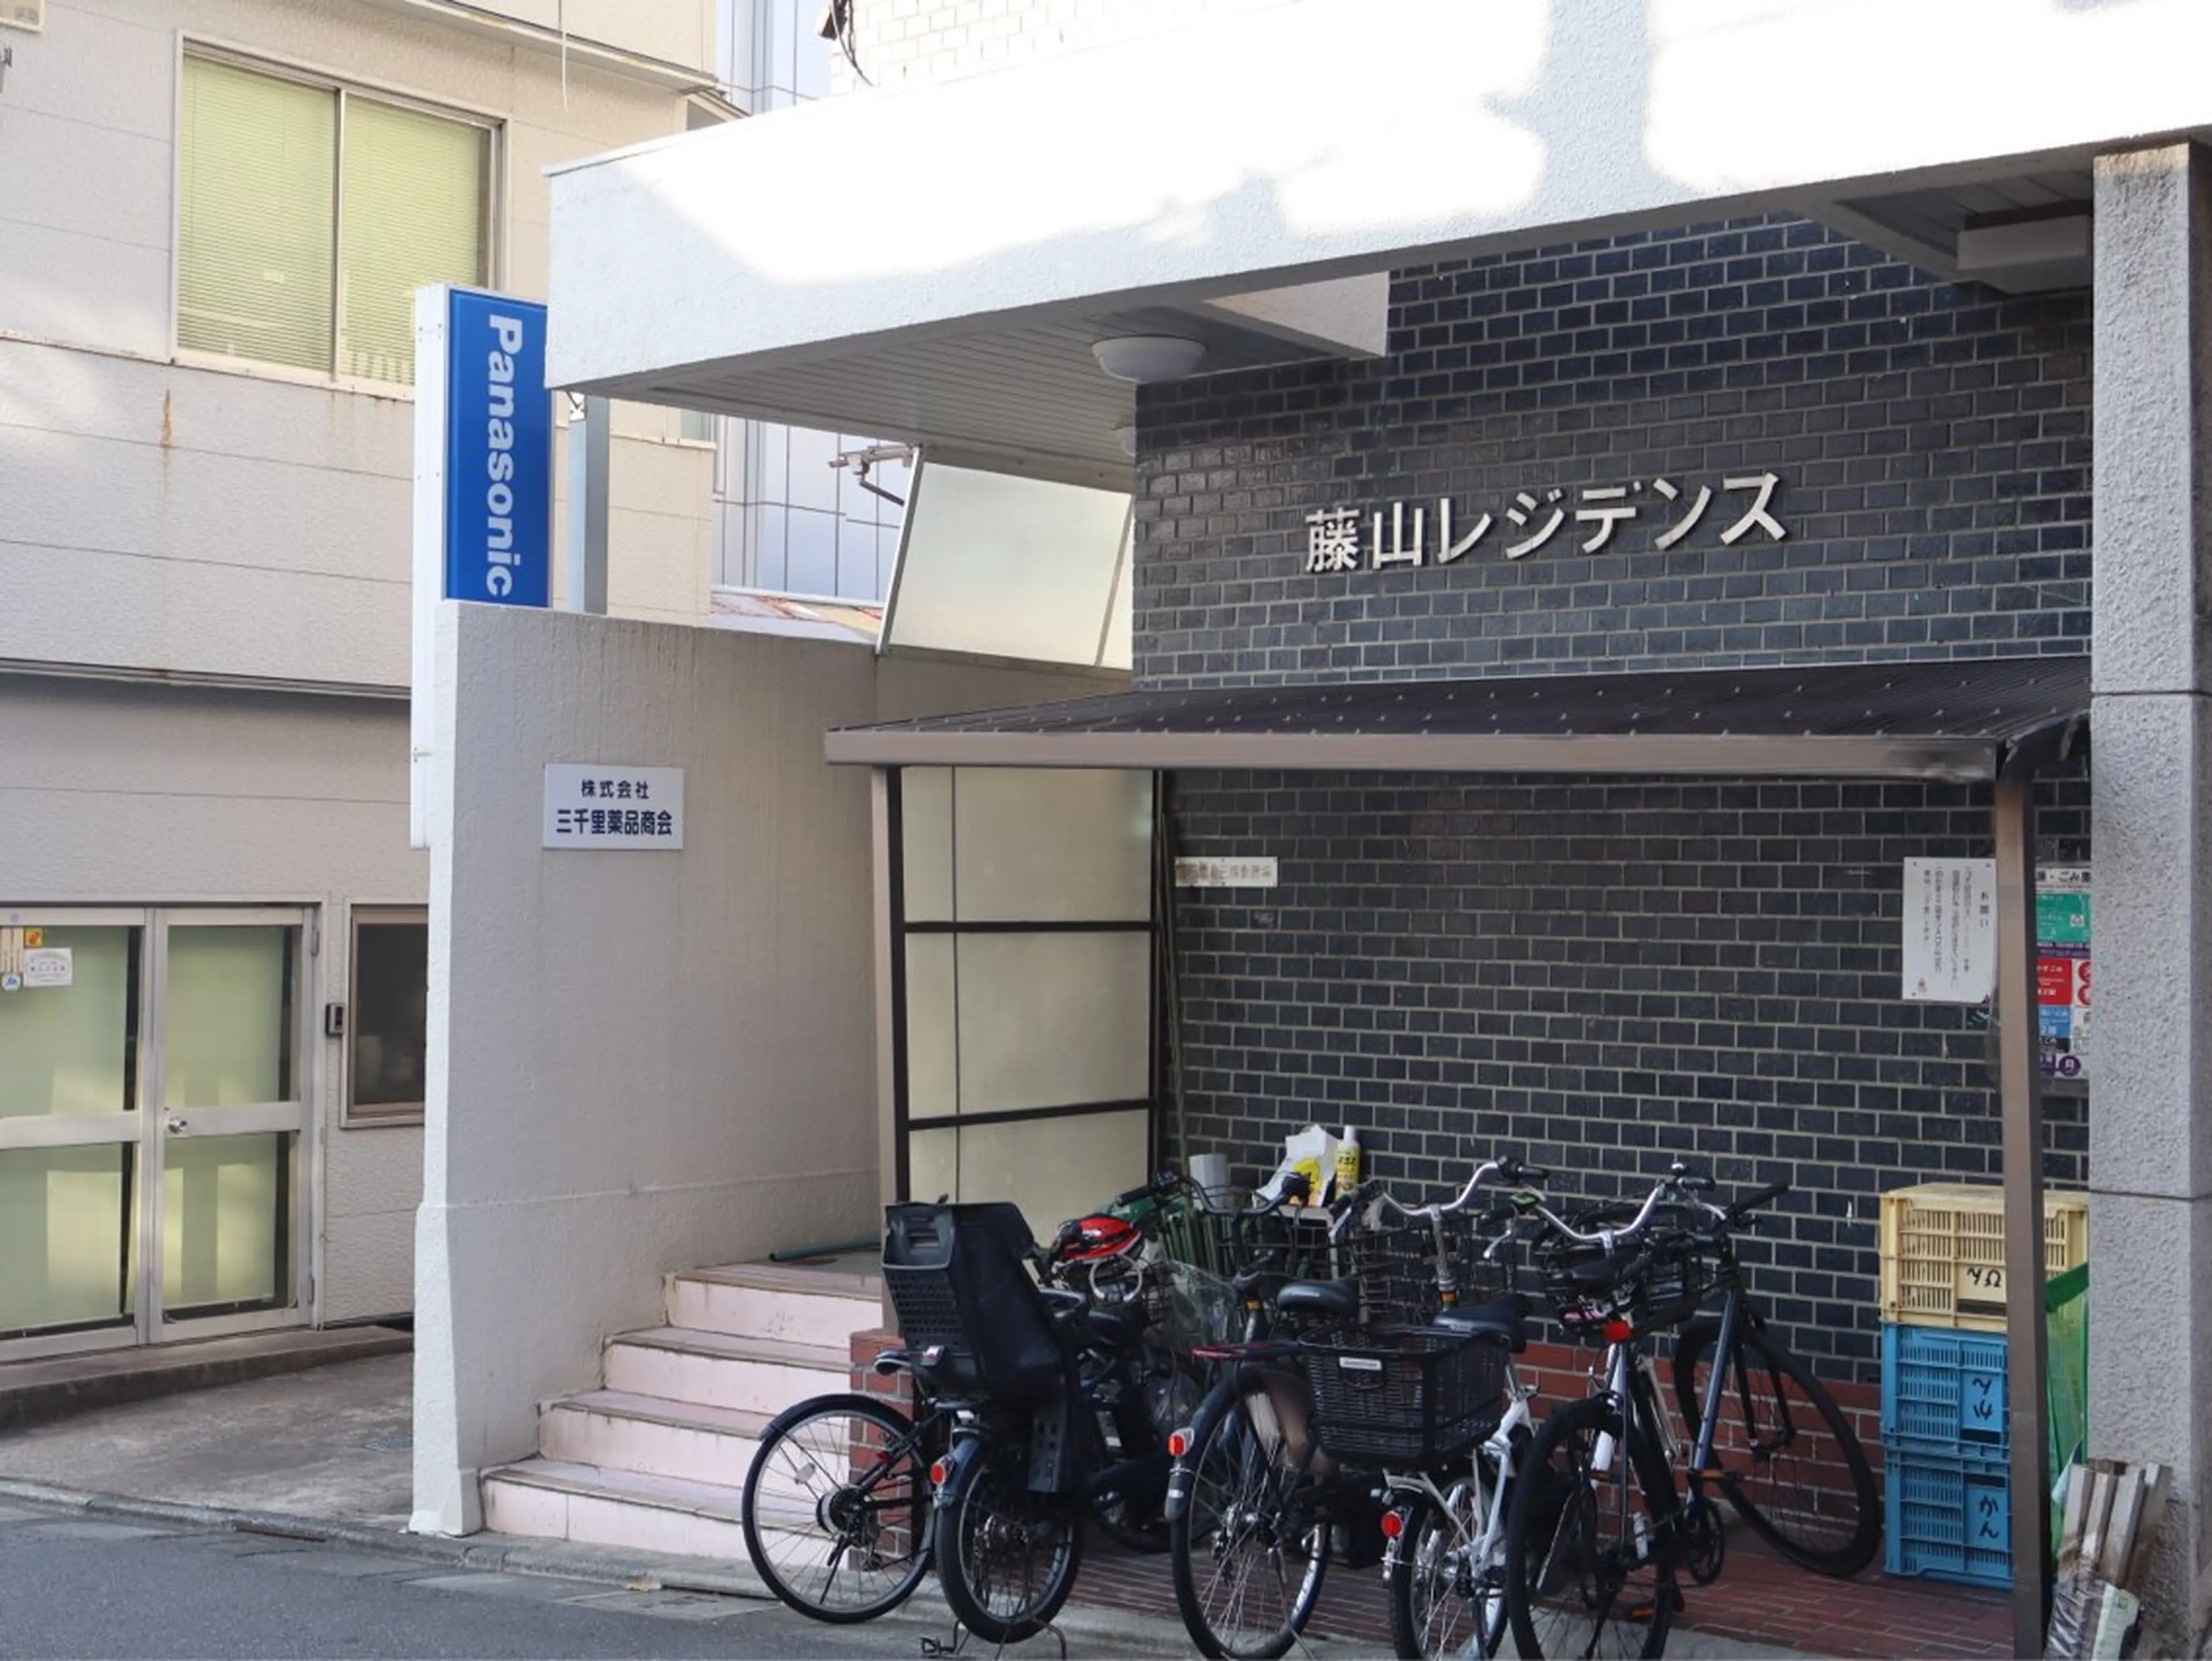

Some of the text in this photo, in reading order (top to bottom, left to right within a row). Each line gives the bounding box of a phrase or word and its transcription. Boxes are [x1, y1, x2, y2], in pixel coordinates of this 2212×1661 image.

[486, 314, 523, 598] Panasonic
[1304, 472, 1787, 573] 藤山レジデンス
[581, 780, 650, 799] 株式会社
[556, 808, 673, 835] 三千里薬品商会
[1972, 1378, 1994, 1421] かん
[1979, 1495, 2000, 1539] かん
